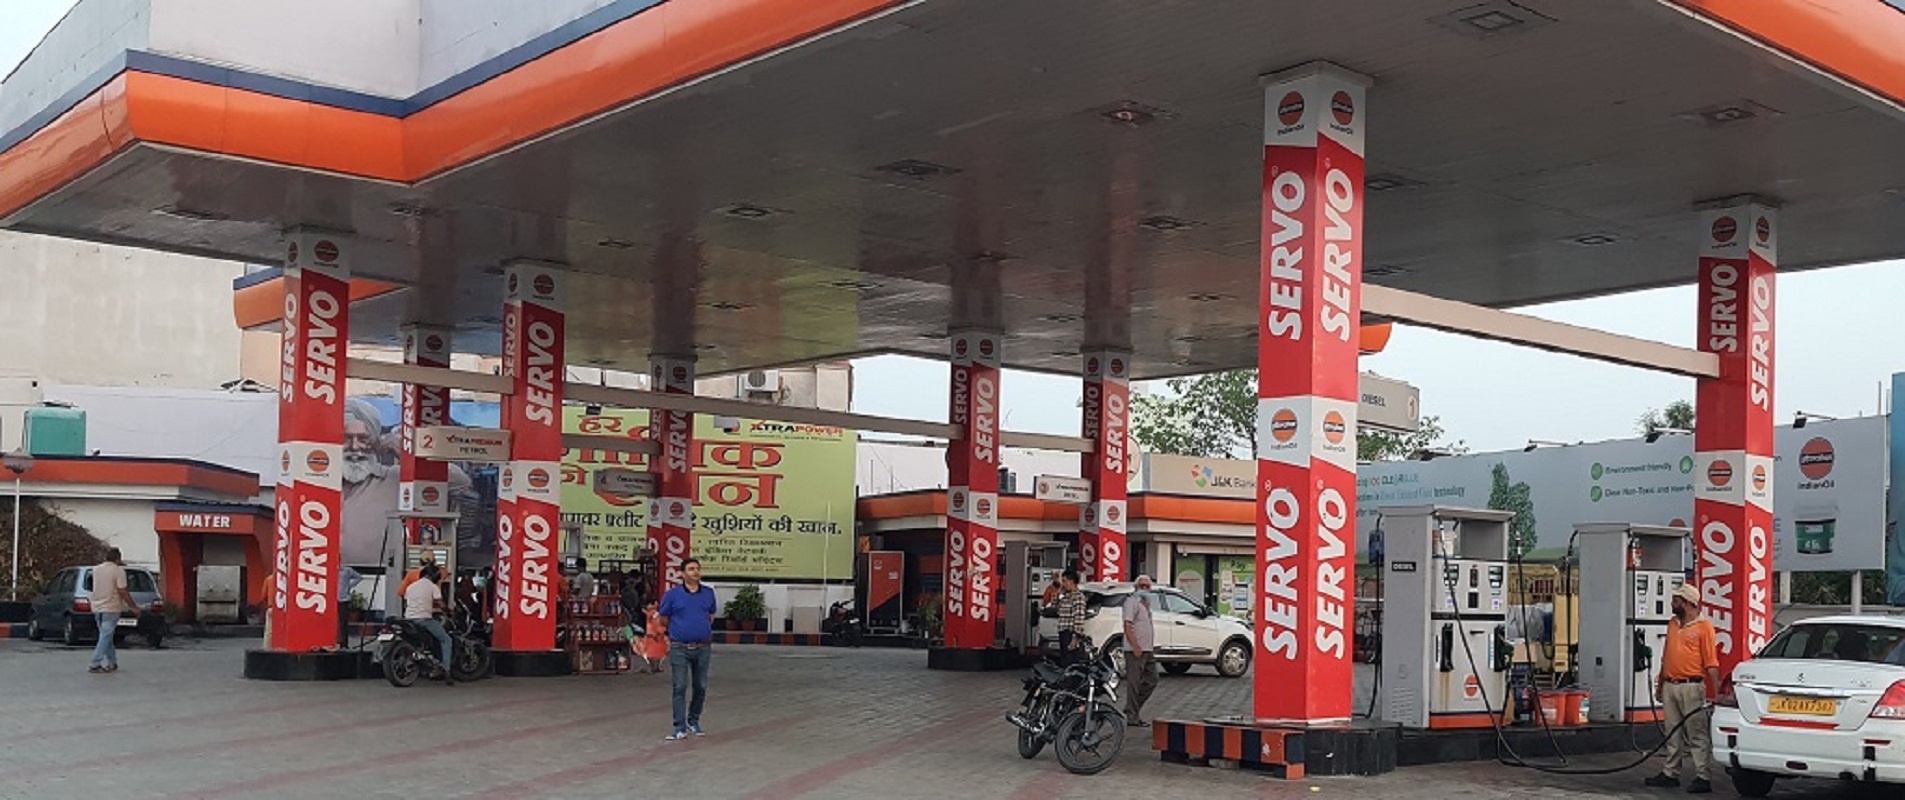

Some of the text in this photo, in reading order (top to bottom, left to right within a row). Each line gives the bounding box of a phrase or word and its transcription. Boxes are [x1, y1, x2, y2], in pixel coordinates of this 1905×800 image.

[1269, 170, 1305, 341] SERVO
[1320, 168, 1353, 343] SERVO
[1710, 263, 1739, 353] SERVO
[282, 292, 297, 404] SERVO
[304, 290, 340, 405] SERVO
[504, 312, 516, 377] SERVO
[526, 321, 555, 427] SERVO
[953, 369, 968, 424] SERVO
[1751, 276, 1770, 411] SERVO
[424, 434, 433, 448] 2
[974, 377, 995, 464] SERVO
[1086, 386, 1098, 438] SERVO
[1105, 394, 1125, 474] SERVO
[1362, 393, 1386, 407] DIESEL
[1409, 398, 1415, 418] 1
[179, 513, 231, 528] WATER
[275, 499, 291, 613] SERVO
[296, 500, 330, 614] SERVO
[495, 513, 513, 620] SERVO
[520, 514, 551, 620] SERVO
[701, 512, 762, 535] खुशियों
[769, 514, 792, 534] की
[1264, 487, 1299, 660] SERVO
[1315, 487, 1347, 660] SERVO
[949, 532, 965, 618] SERVO
[970, 537, 992, 622] SERVO
[1701, 520, 1735, 655] SERVO
[1749, 526, 1767, 657] SERVO
